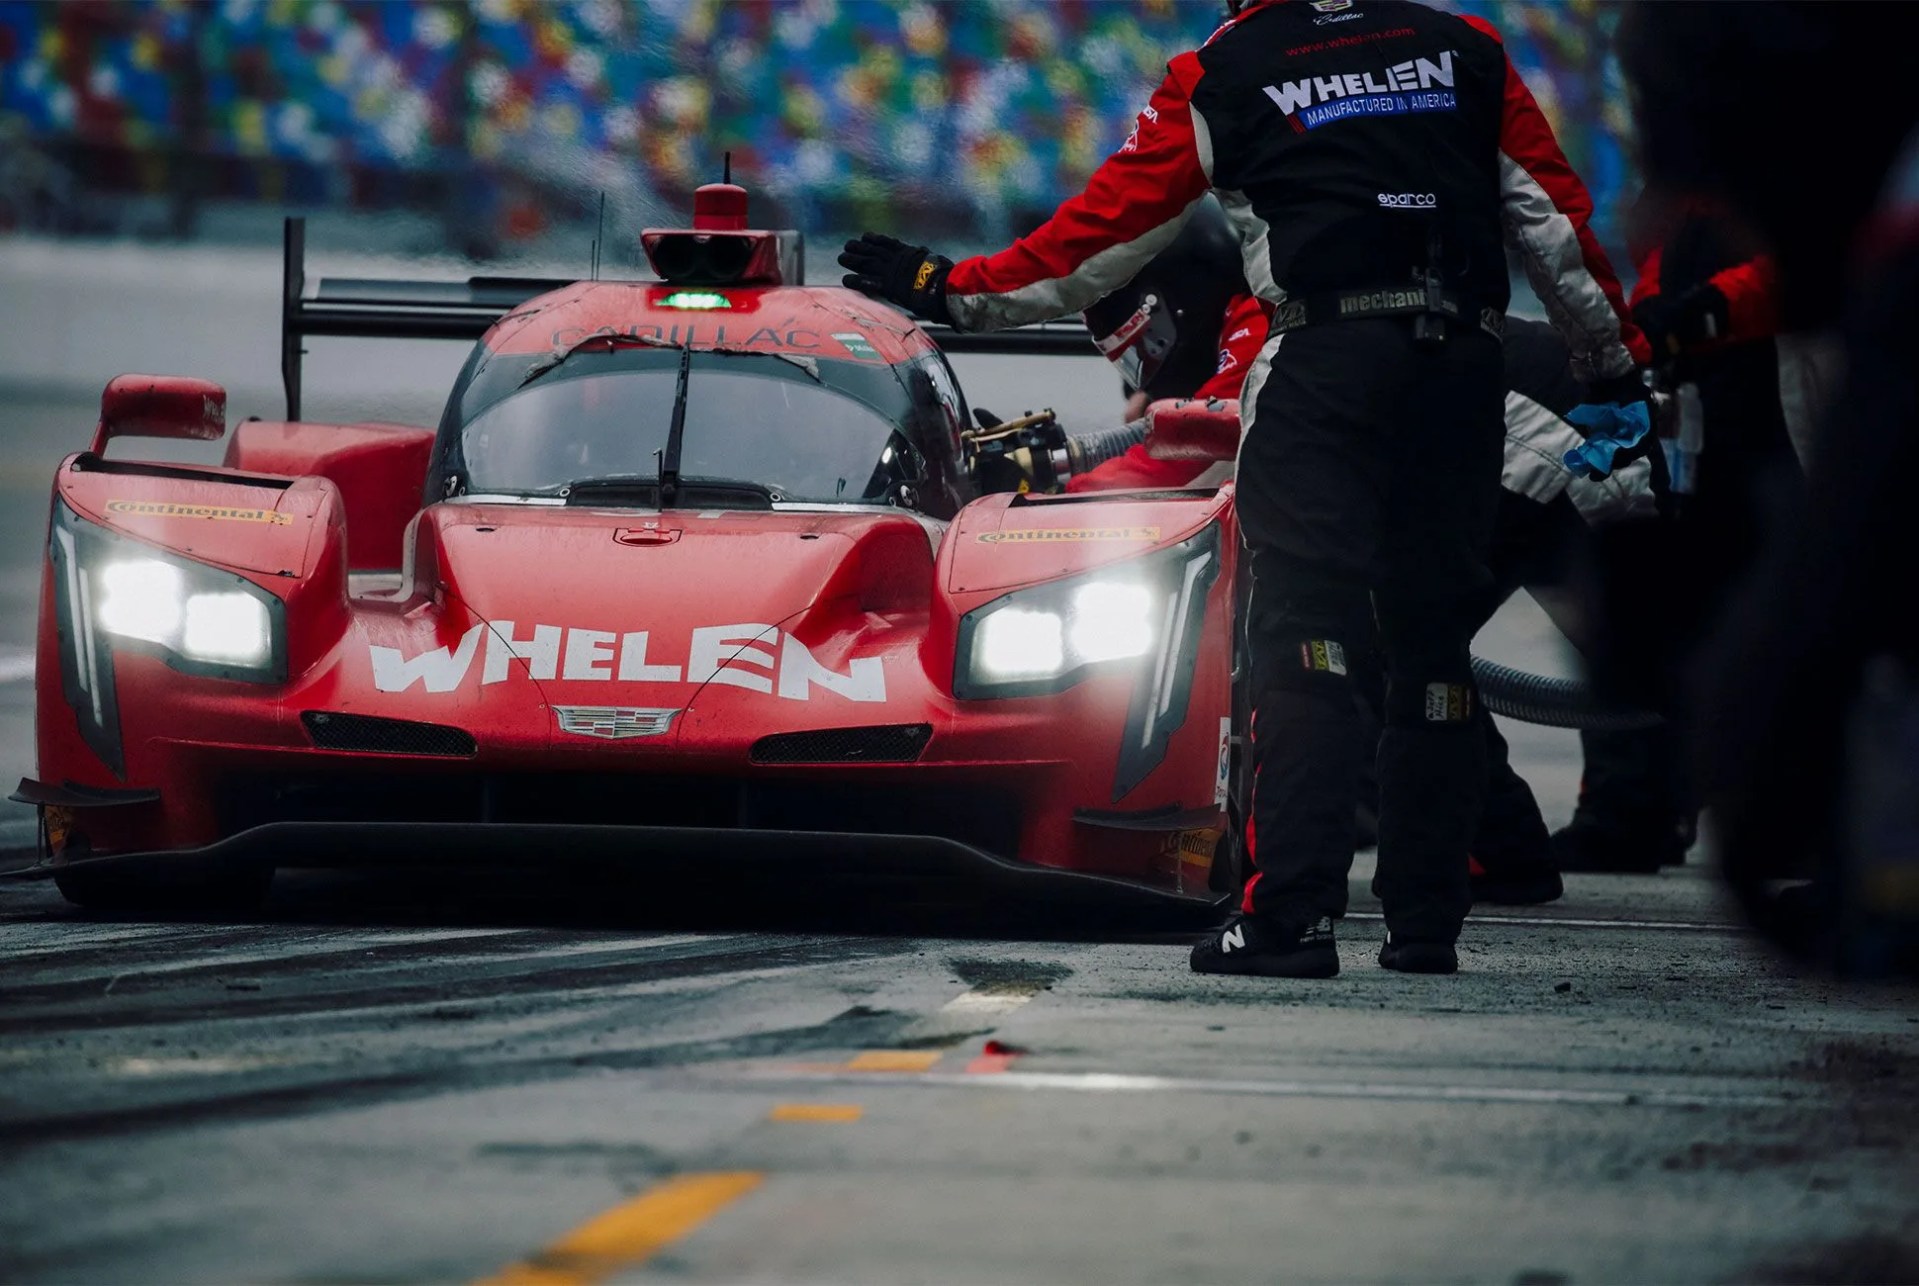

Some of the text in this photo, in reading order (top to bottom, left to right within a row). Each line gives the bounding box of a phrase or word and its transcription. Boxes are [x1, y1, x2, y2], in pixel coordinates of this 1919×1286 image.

[1262, 50, 1455, 116] WHELEN
[1307, 93, 1457, 126] MANUFACTURED IN AMERICA
[1377, 193, 1437, 209] sparco
[369, 620, 887, 702] WHELEN
